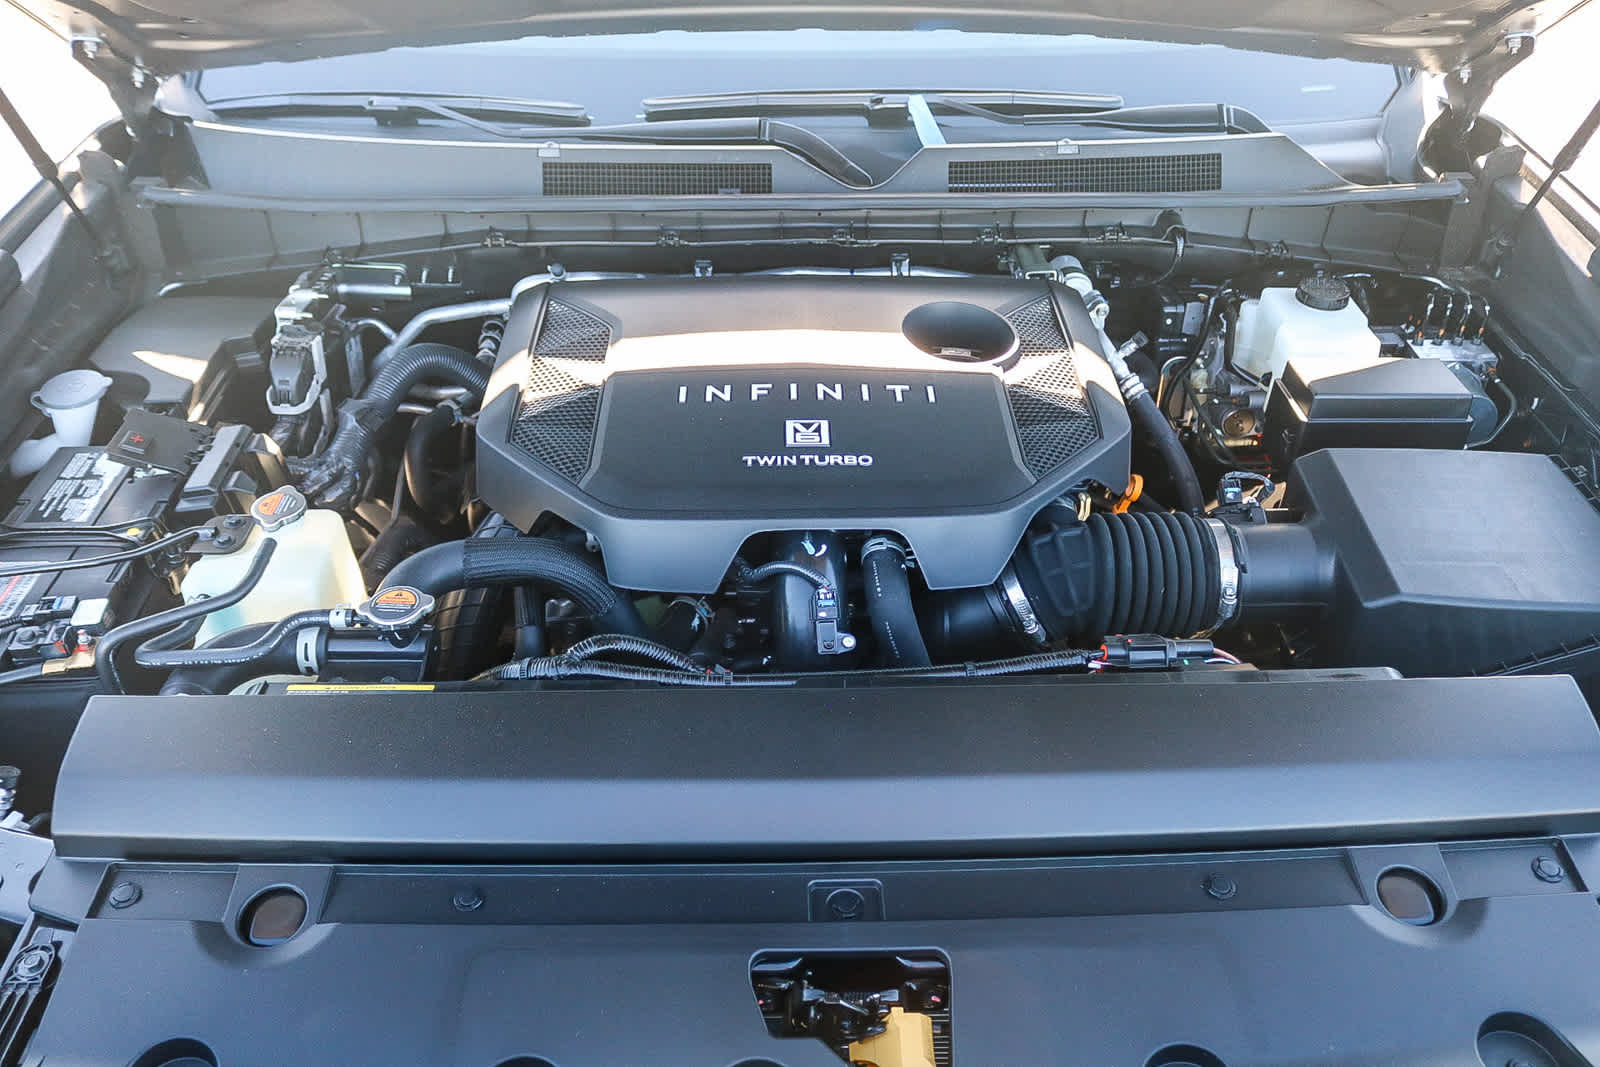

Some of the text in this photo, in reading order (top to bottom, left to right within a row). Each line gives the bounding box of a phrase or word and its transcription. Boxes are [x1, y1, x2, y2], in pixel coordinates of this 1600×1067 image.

[678, 383, 936, 403] INFINITI
[742, 454, 873, 466] TWIN TURBO
